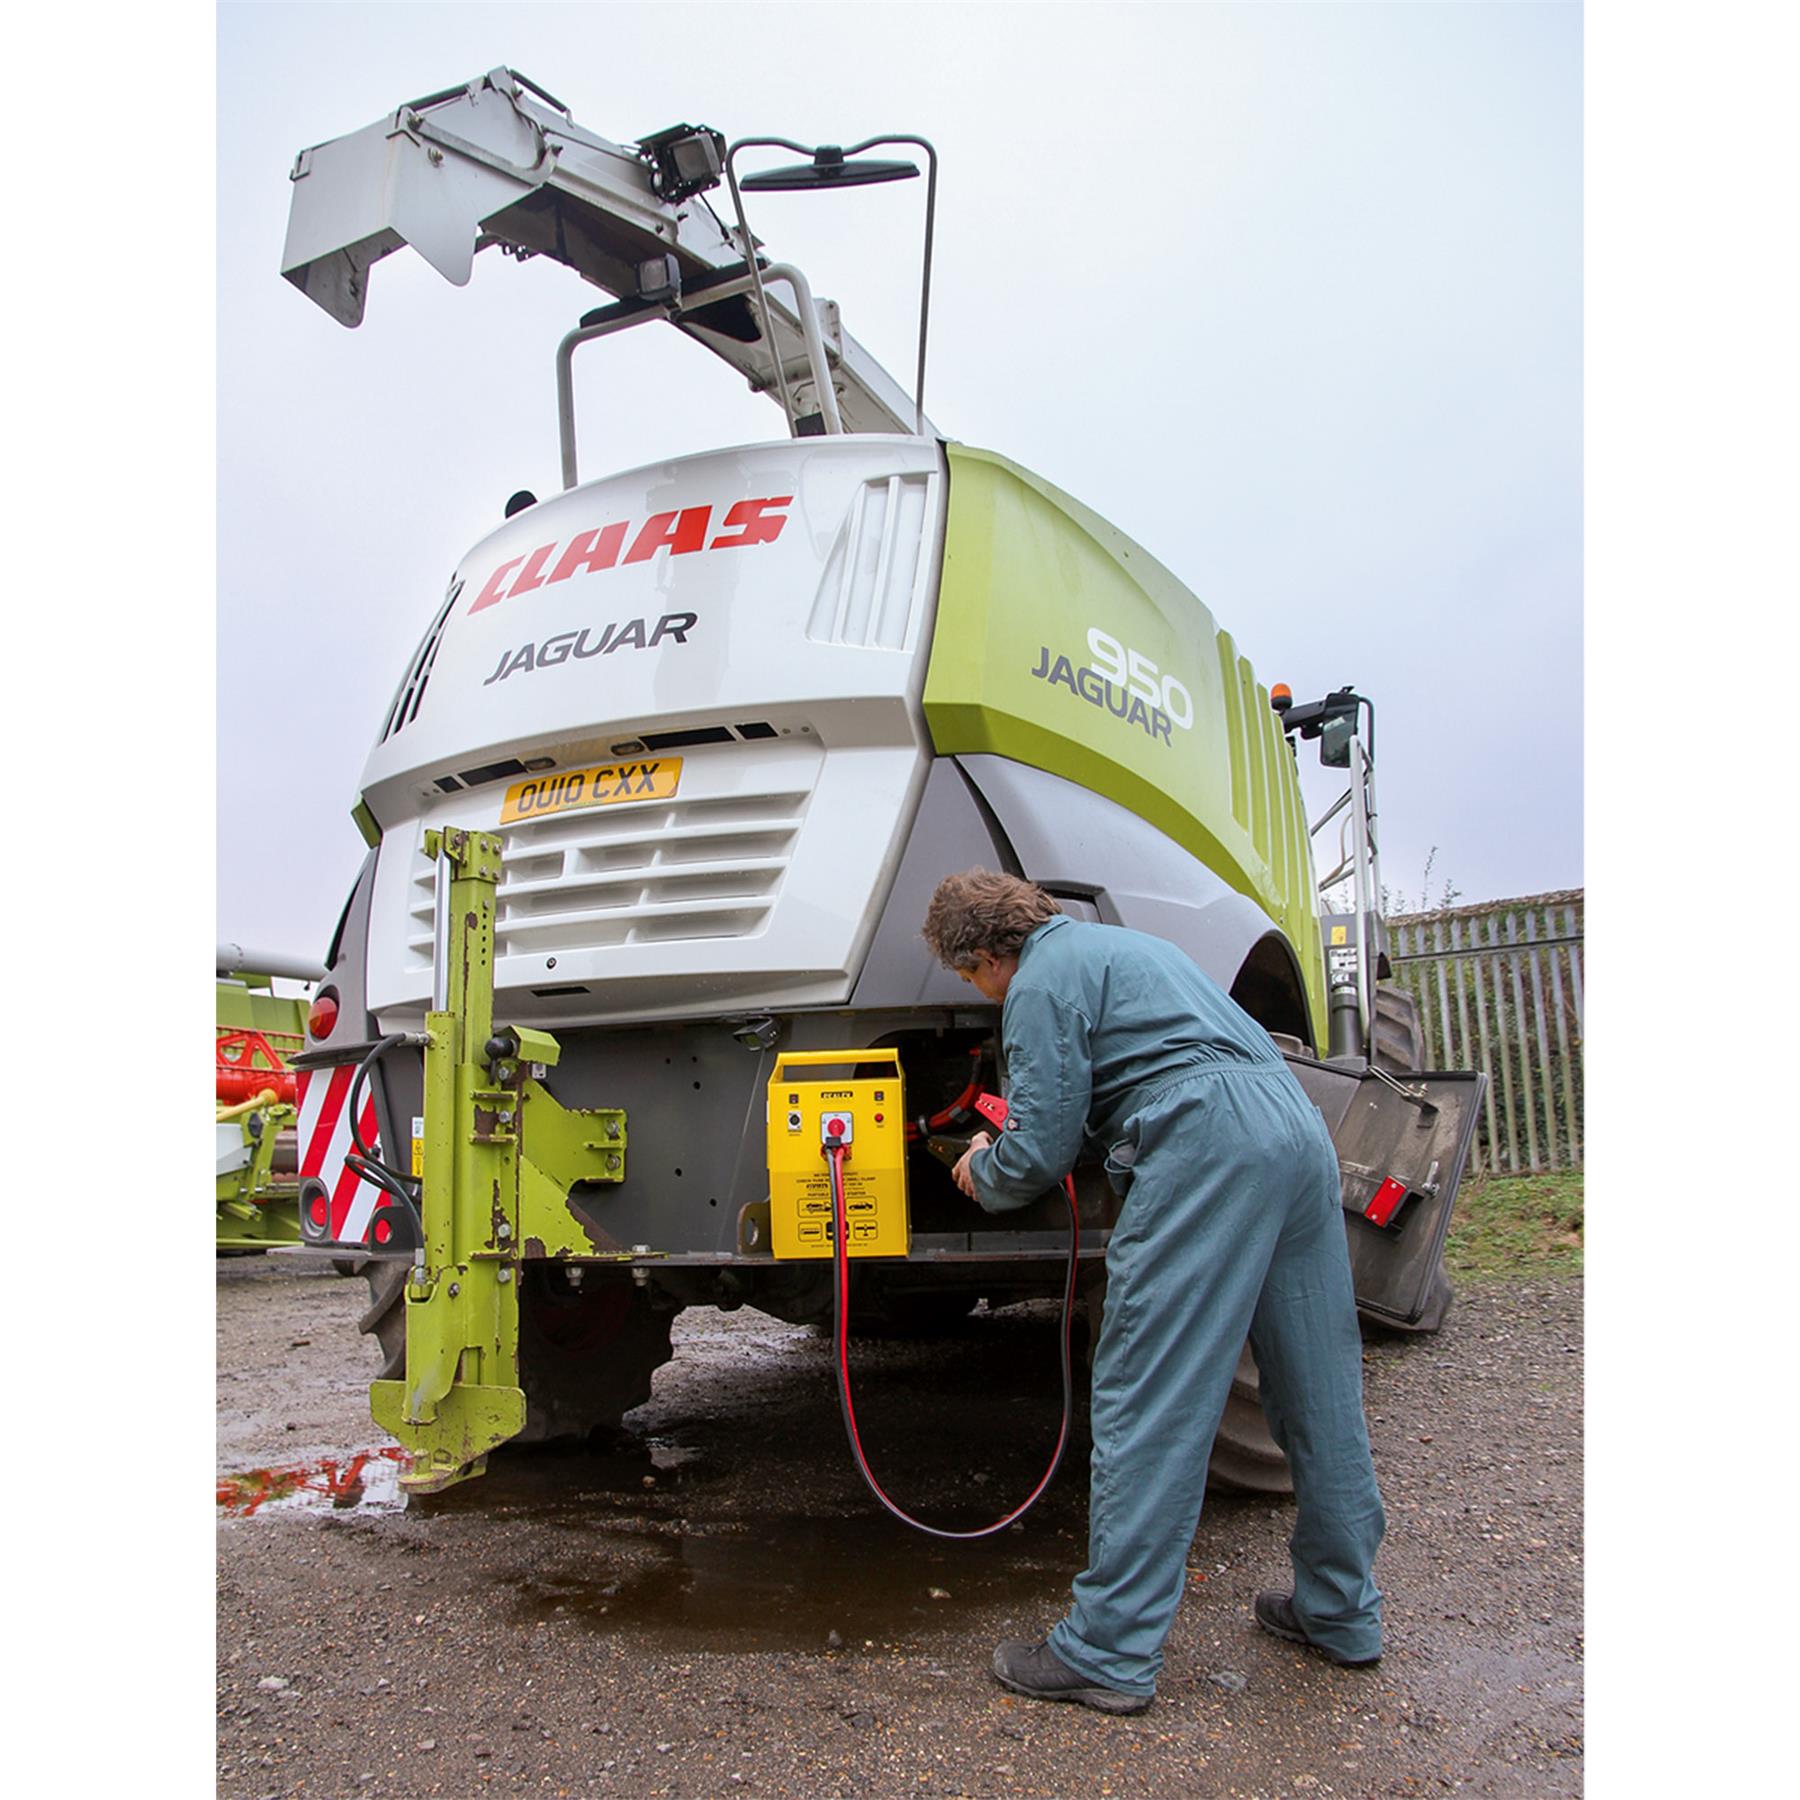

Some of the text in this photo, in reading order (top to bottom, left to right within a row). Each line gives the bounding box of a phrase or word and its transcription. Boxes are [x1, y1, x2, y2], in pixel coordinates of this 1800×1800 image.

[467, 496, 793, 616] CLAAS
[483, 612, 698, 686] JAGUAR
[1031, 646, 1172, 748] JAGUAR
[1087, 627, 1194, 730] 950
[517, 763, 660, 813] OU10 CXX
